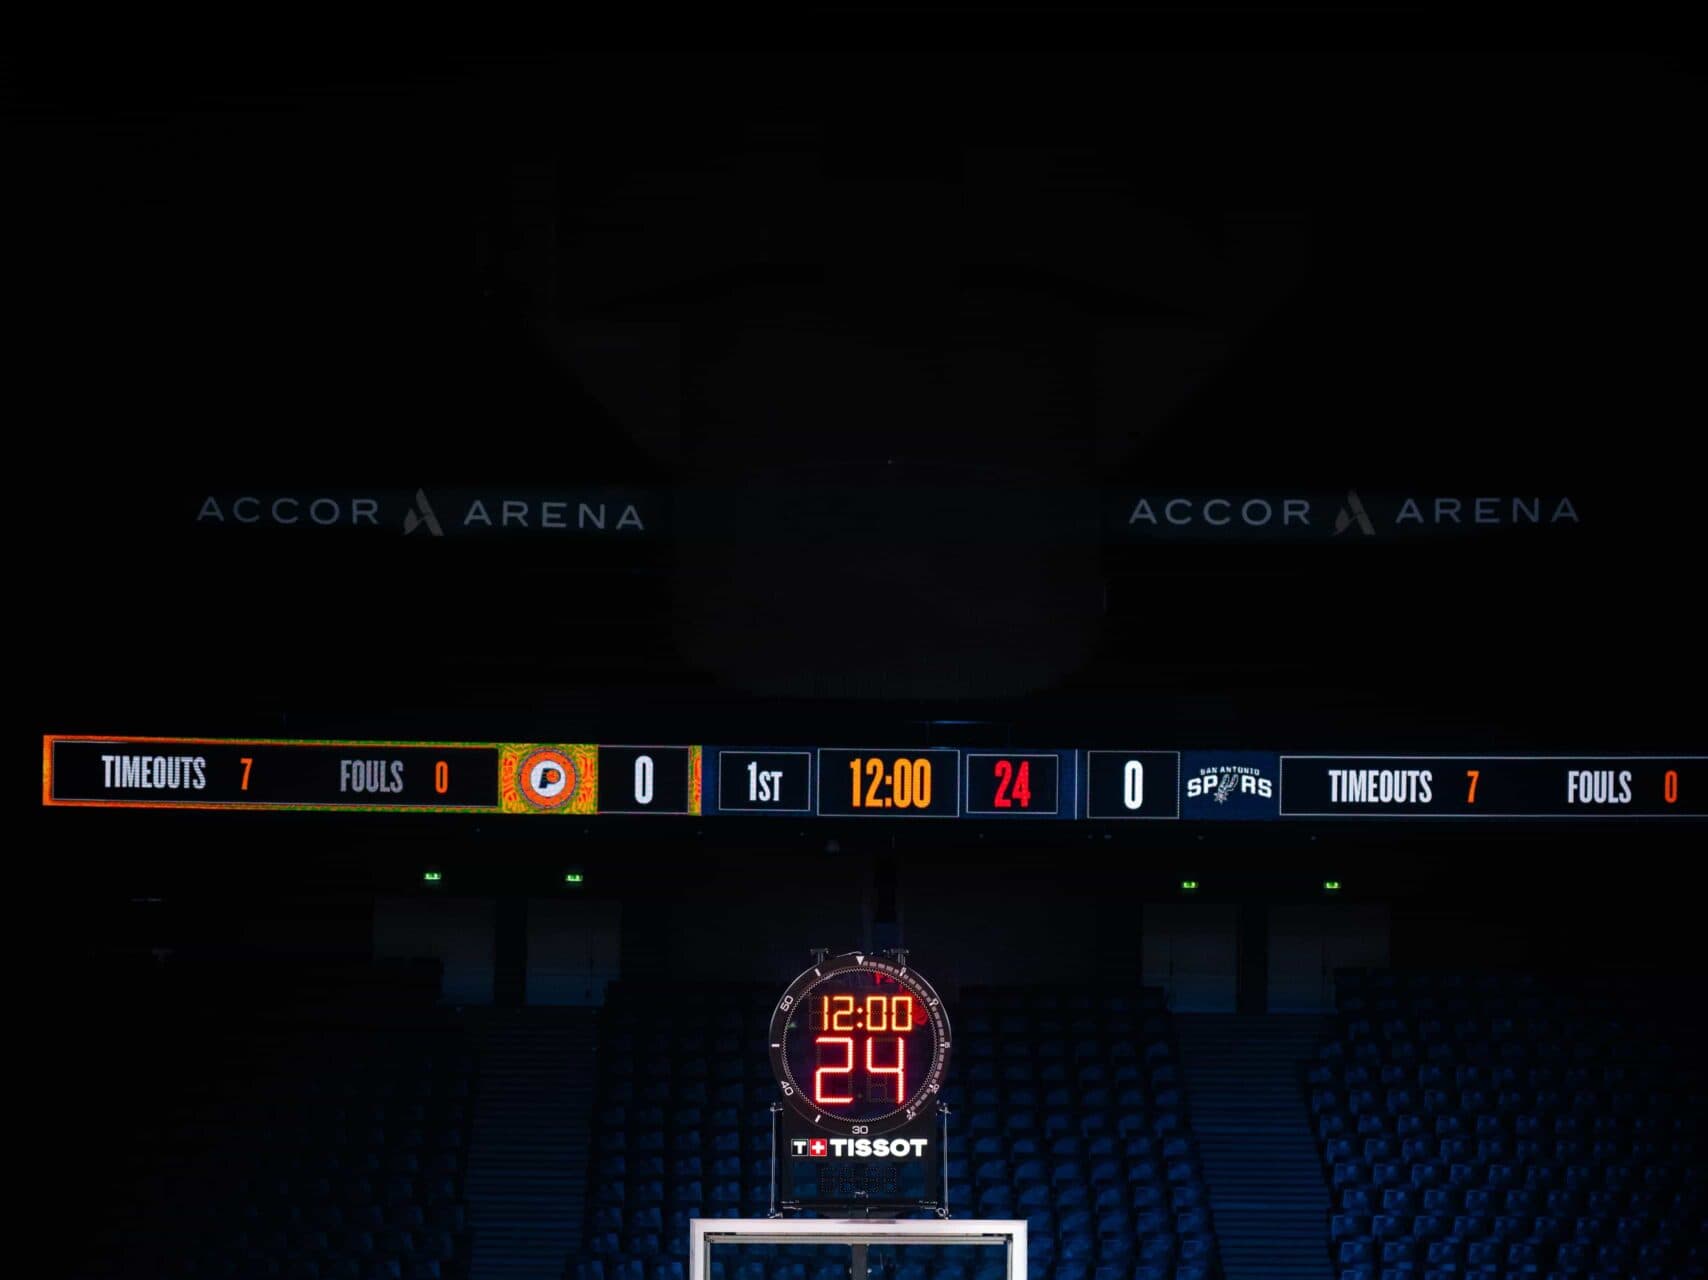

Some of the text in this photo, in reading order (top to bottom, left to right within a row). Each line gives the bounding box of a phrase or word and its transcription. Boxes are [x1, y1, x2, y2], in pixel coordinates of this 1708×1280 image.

[196, 495, 646, 531] ACCOR ARENA
[1128, 496, 1583, 527] ACCOR ARENA
[101, 754, 254, 791] TIMEOUTS 7
[339, 759, 449, 794] FOULS 0
[634, 755, 654, 805] 0
[747, 761, 783, 802] 1ST
[850, 758, 932, 809] 12:00
[994, 760, 1032, 808] 24
[1123, 760, 1144, 810] 0
[1200, 765, 1260, 777] SAN ANTONIO
[1327, 768, 1481, 805] TIMEOUTS 7
[1567, 769, 1679, 805] FOULS 0
[779, 995, 794, 1012] 50
[822, 996, 914, 1032] 12:00
[779, 1079, 795, 1097] 40
[815, 1036, 905, 1105] 24
[829, 1138, 928, 1157] TISSOT
[851, 1124, 869, 1136] 30
